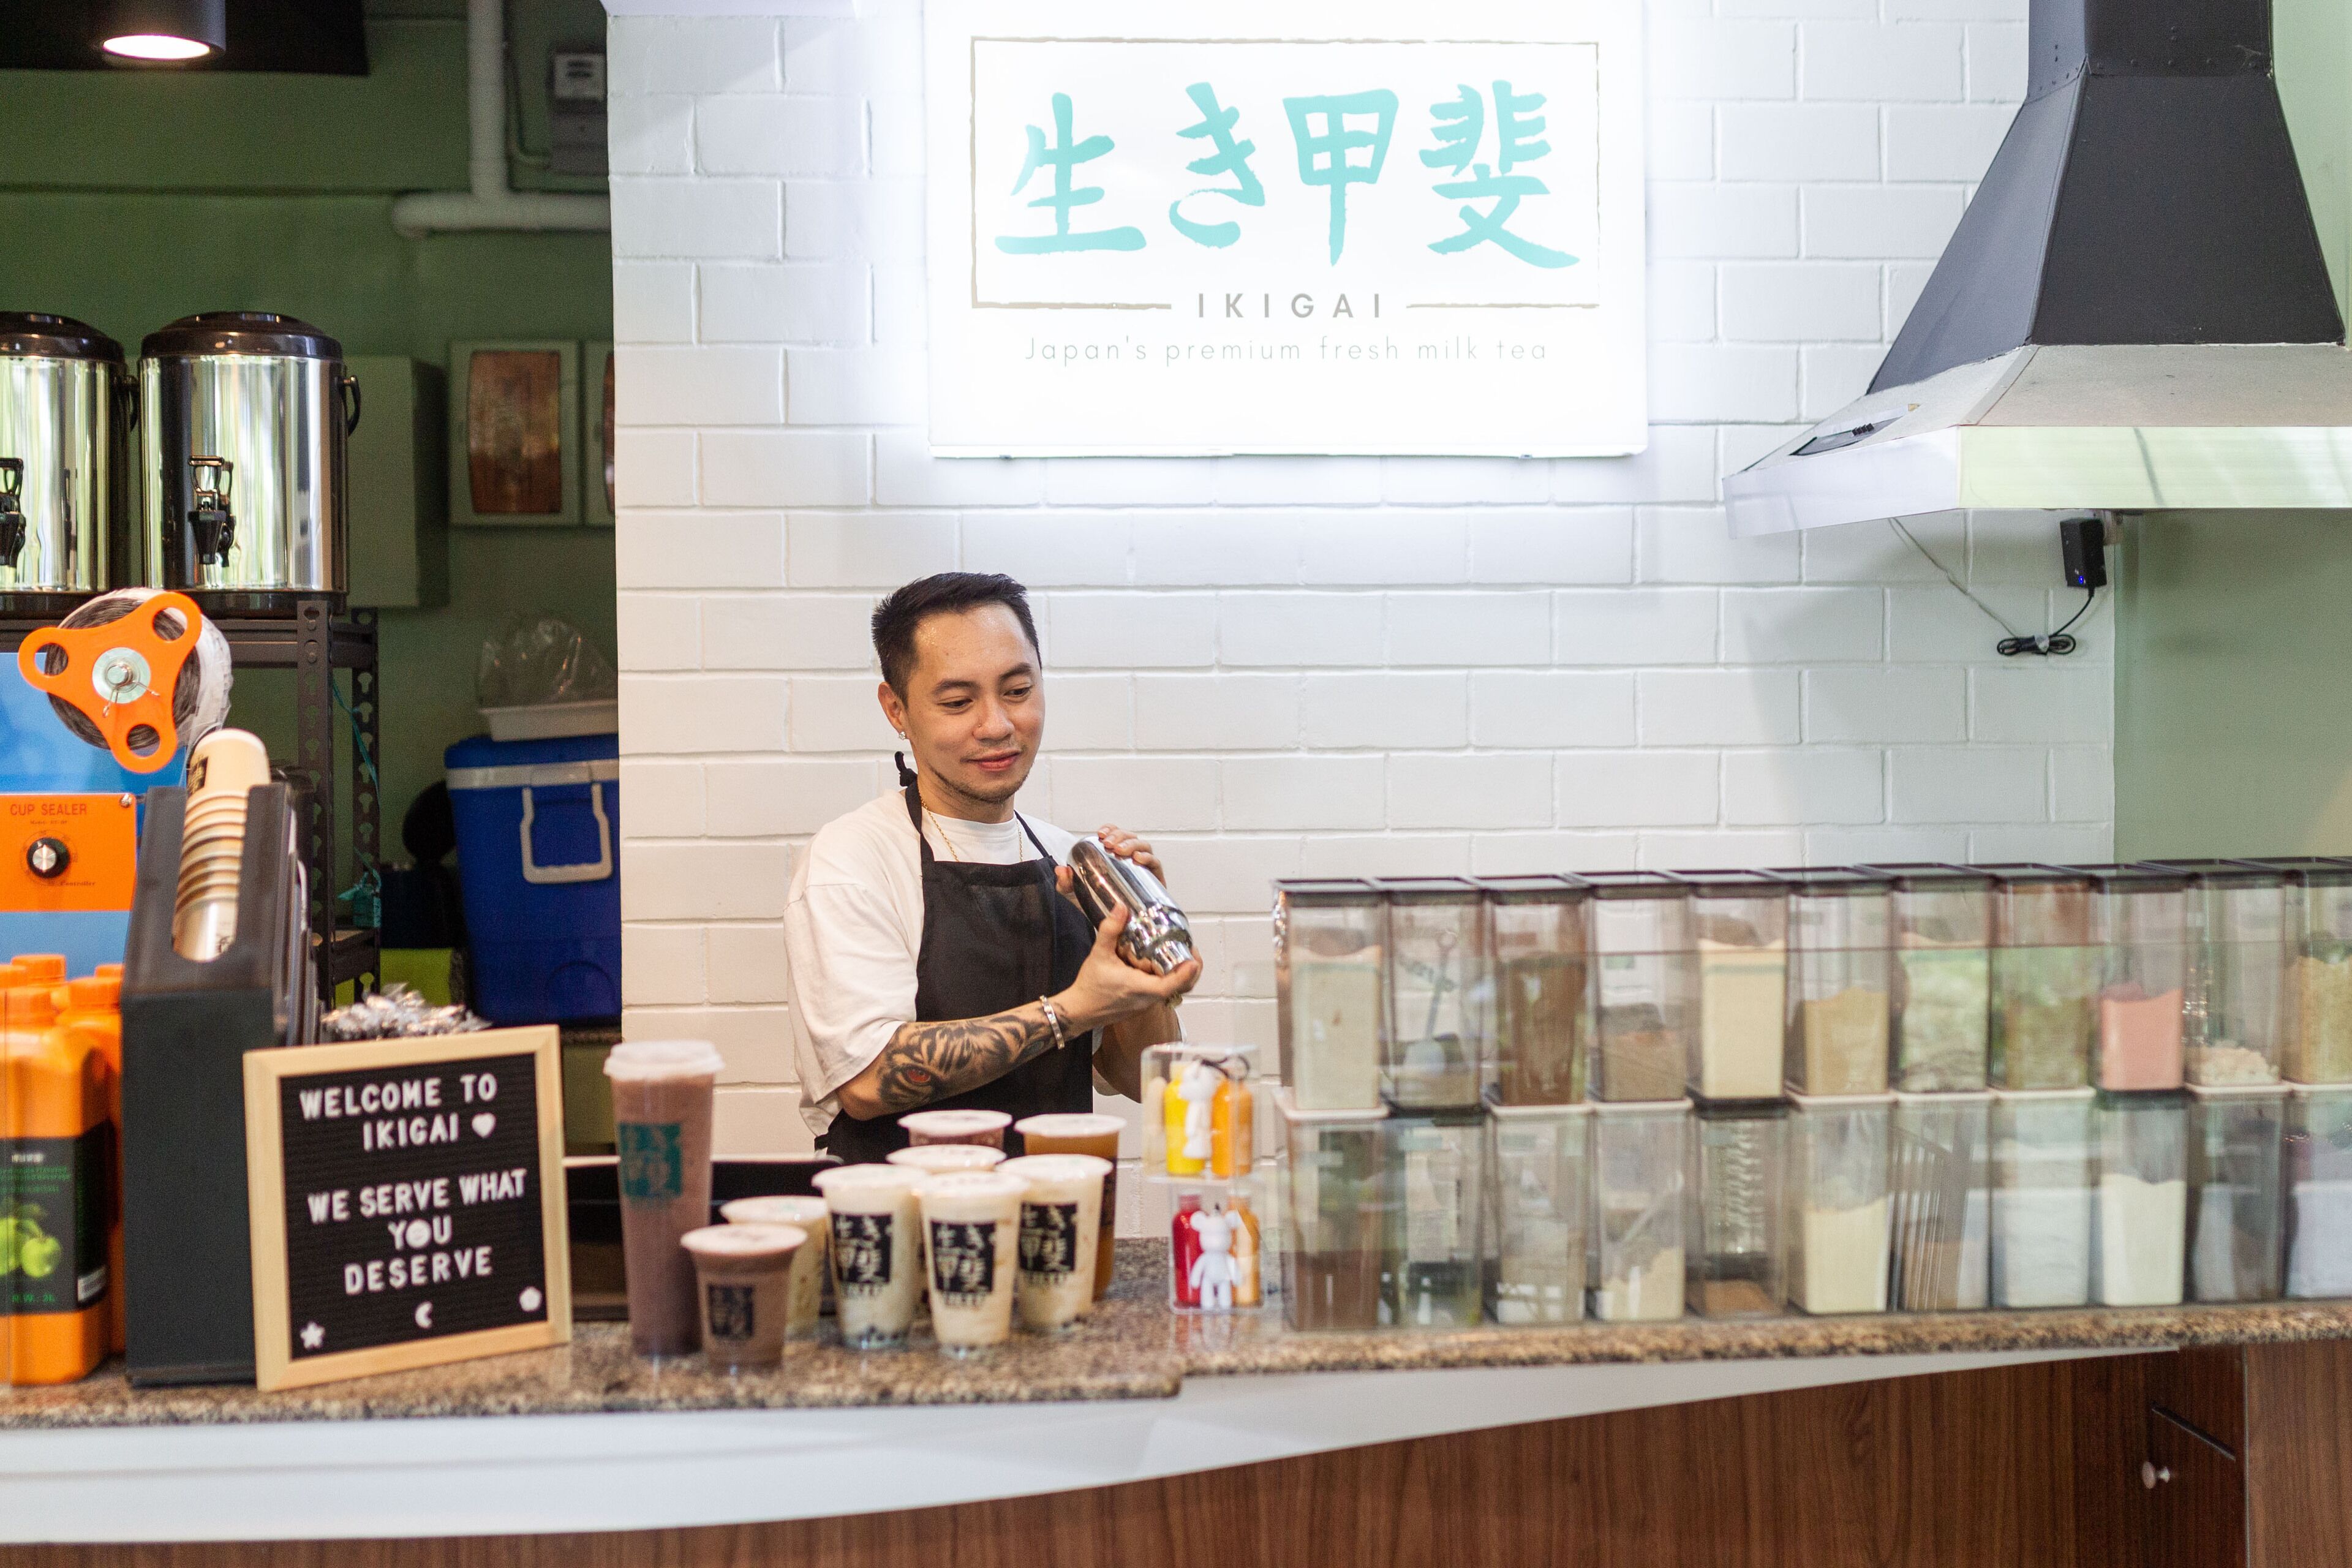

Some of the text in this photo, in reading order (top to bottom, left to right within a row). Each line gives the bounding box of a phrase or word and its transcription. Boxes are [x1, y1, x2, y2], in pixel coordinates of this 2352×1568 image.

[995, 80, 1580, 268] 生き甲斐
[1198, 293, 1379, 318] IKIGAI
[1025, 335, 1546, 367] Japan's premium fresh milk tea
[10, 803, 87, 816] CUP SEALER
[300, 1072, 497, 1120] WELCOME TO
[363, 1112, 460, 1152] IKIGAI
[307, 1168, 527, 1224] WE SERVE WHAT
[344, 1246, 493, 1295] DESERVE
